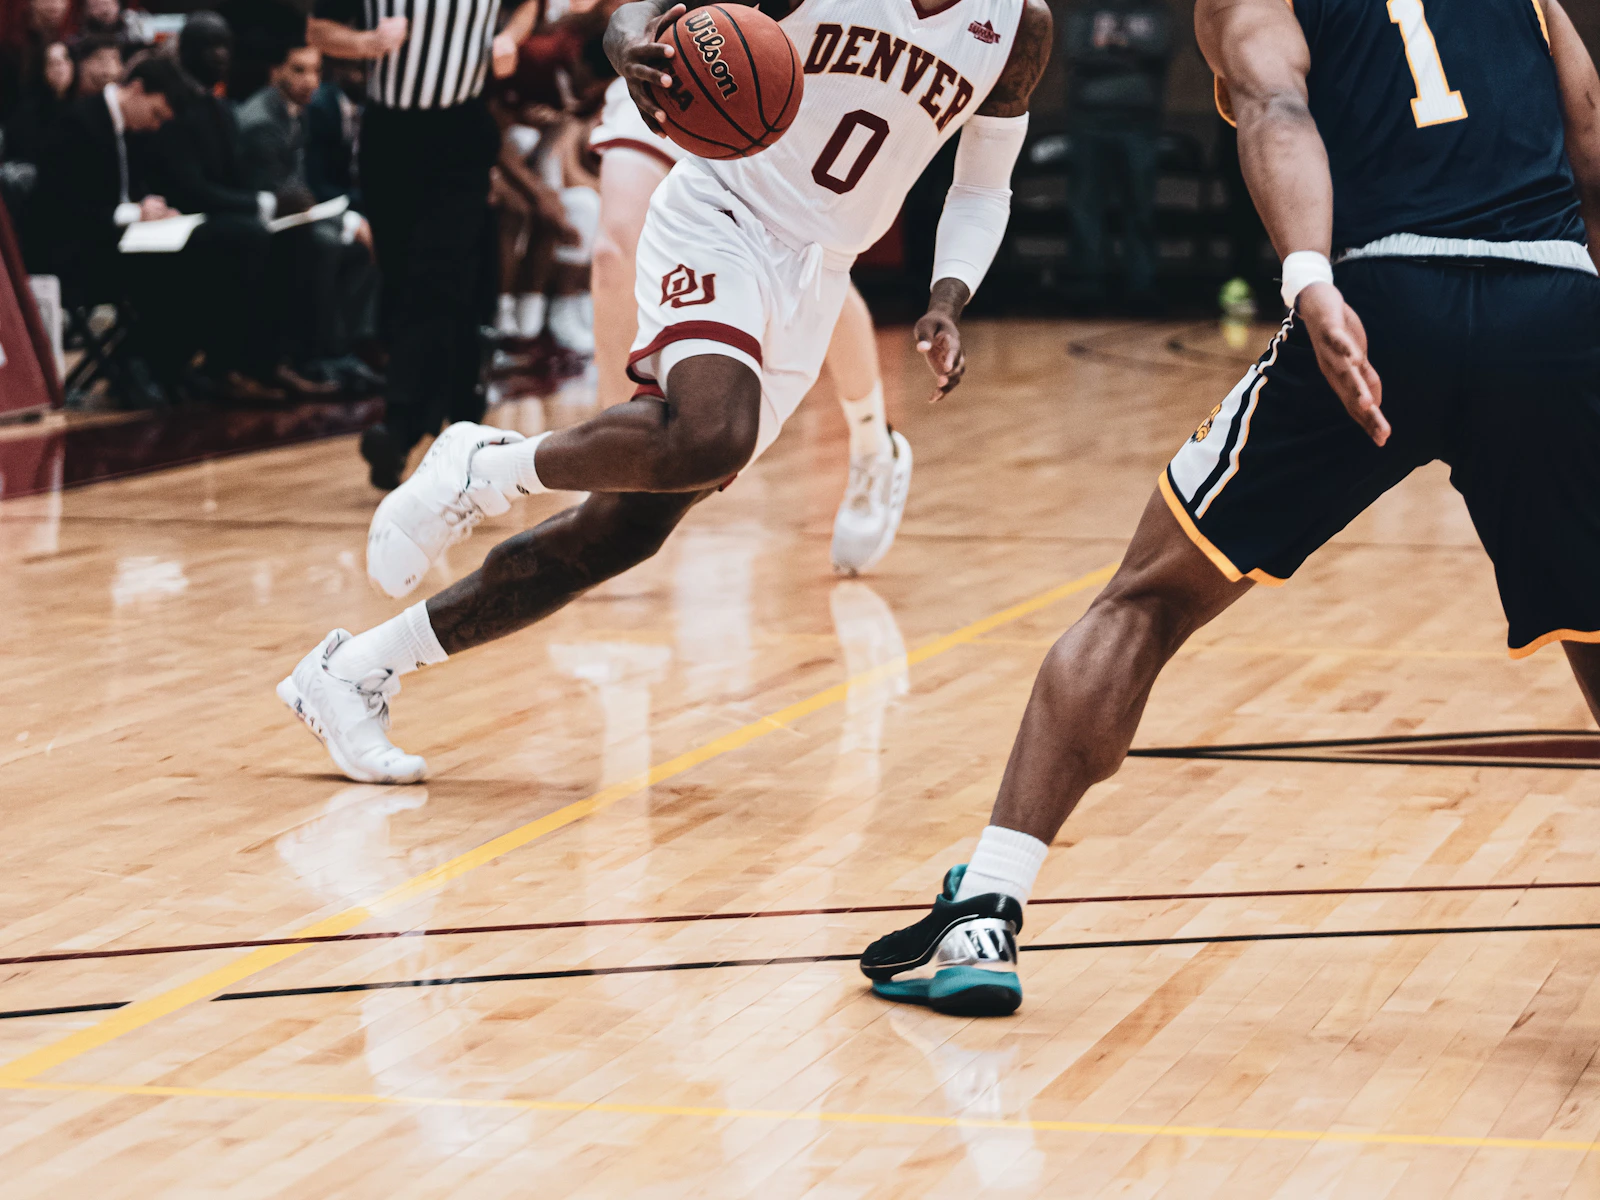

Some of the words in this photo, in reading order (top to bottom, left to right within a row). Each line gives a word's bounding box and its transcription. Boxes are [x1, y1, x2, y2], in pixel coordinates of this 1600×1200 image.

[684, 9, 739, 101] Wilson
[803, 22, 974, 134] DENVER
[811, 109, 891, 195] 0
